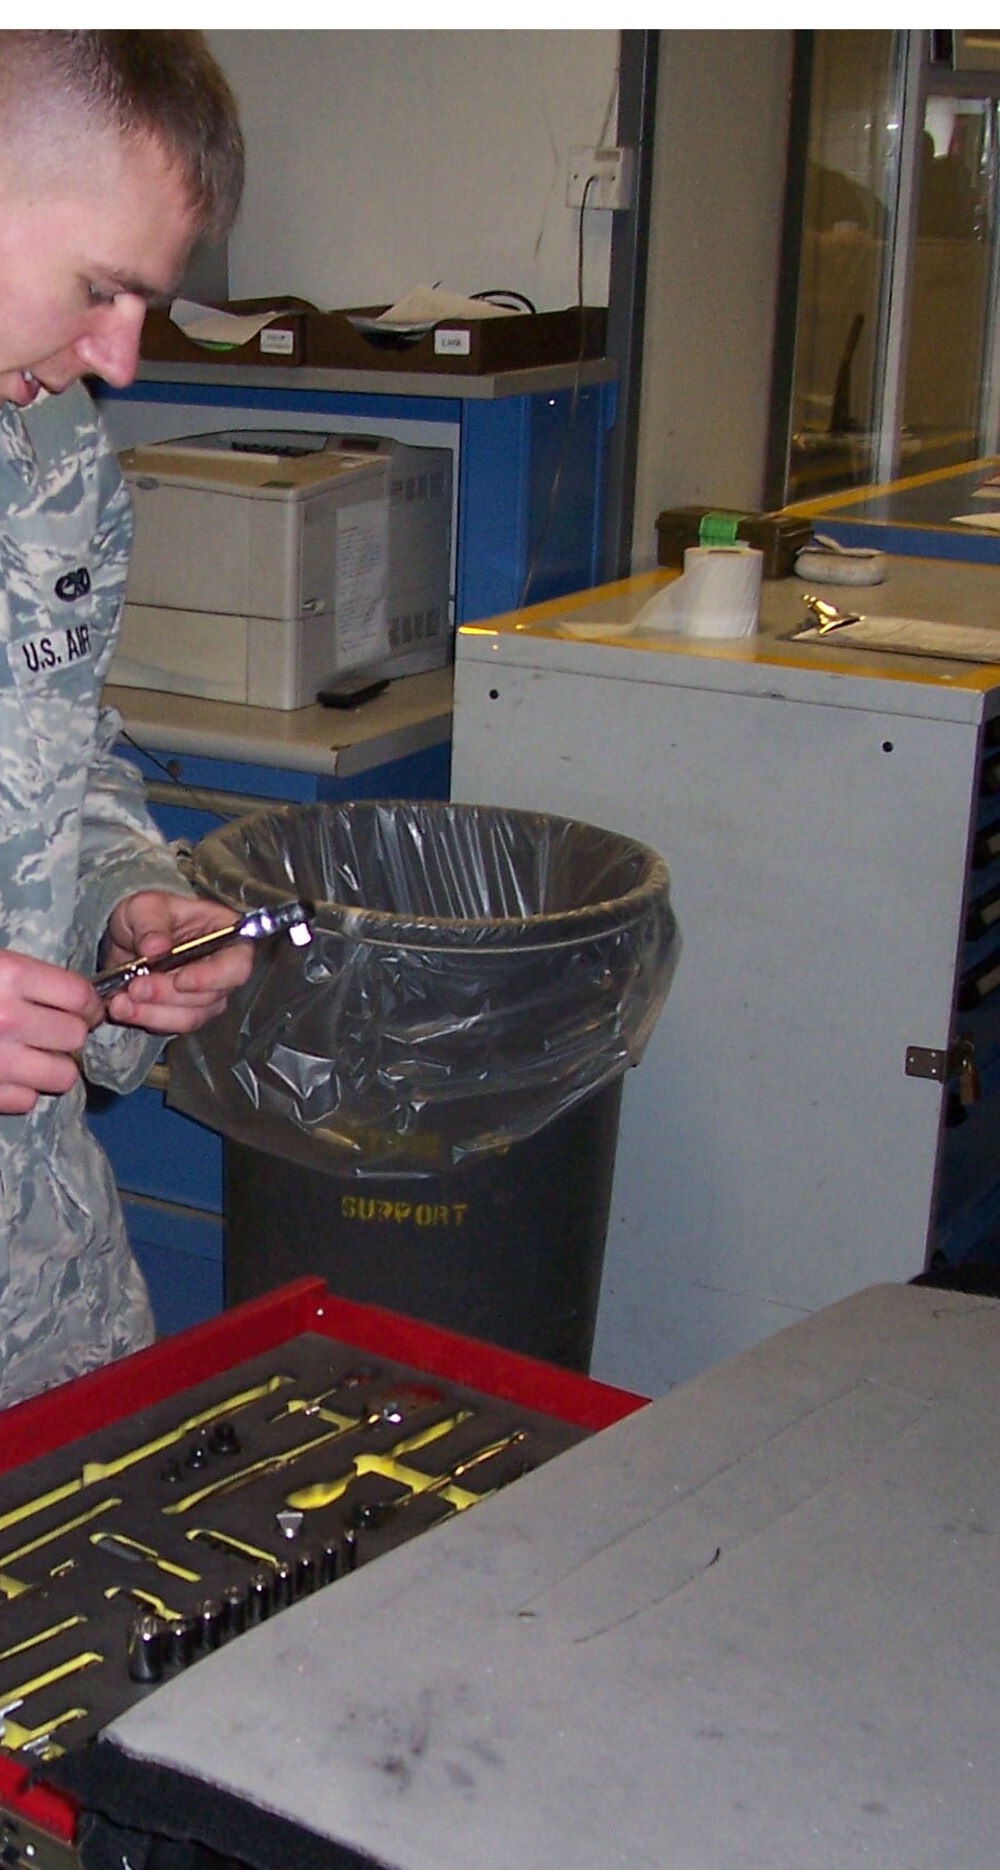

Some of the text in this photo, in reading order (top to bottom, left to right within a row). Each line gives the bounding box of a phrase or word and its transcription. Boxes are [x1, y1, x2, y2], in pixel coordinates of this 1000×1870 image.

[22, 623, 92, 673] U.S. AIR
[340, 1195, 468, 1227] SUPPORT
